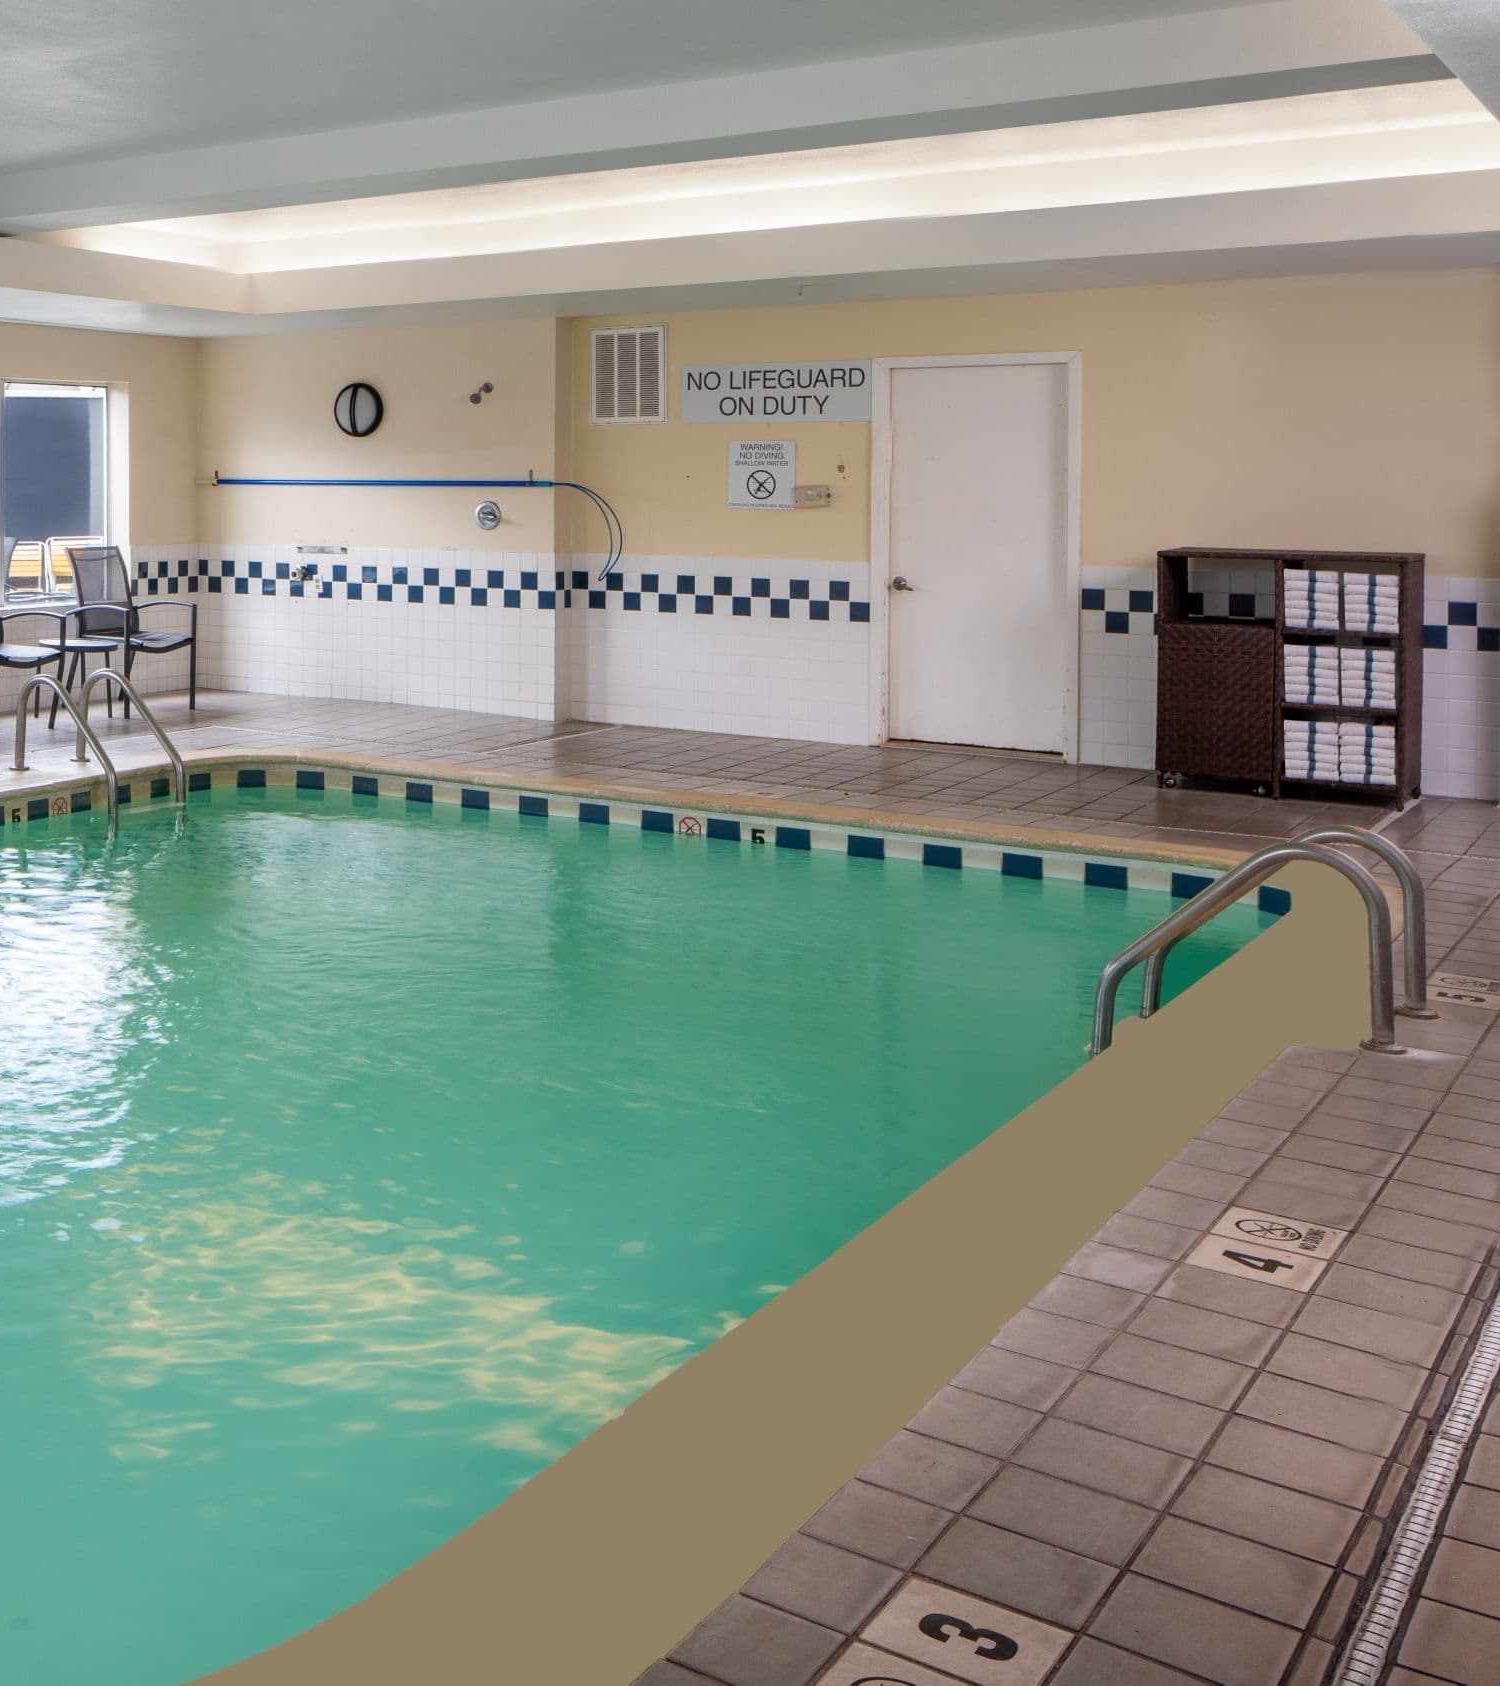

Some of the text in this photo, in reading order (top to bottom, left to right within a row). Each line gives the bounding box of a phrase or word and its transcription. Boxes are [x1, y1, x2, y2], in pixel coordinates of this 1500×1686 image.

[687, 367, 865, 391] NO LIFEGUARD
[719, 395, 829, 416] ON DUTY
[740, 443, 783, 451] WARNING!
[739, 452, 784, 460] NO DIVING
[11, 808, 21, 823] 5
[751, 828, 765, 844] 5
[1436, 991, 1486, 1003] 5
[1222, 1249, 1294, 1273] 4
[918, 1612, 1019, 1662] 3
